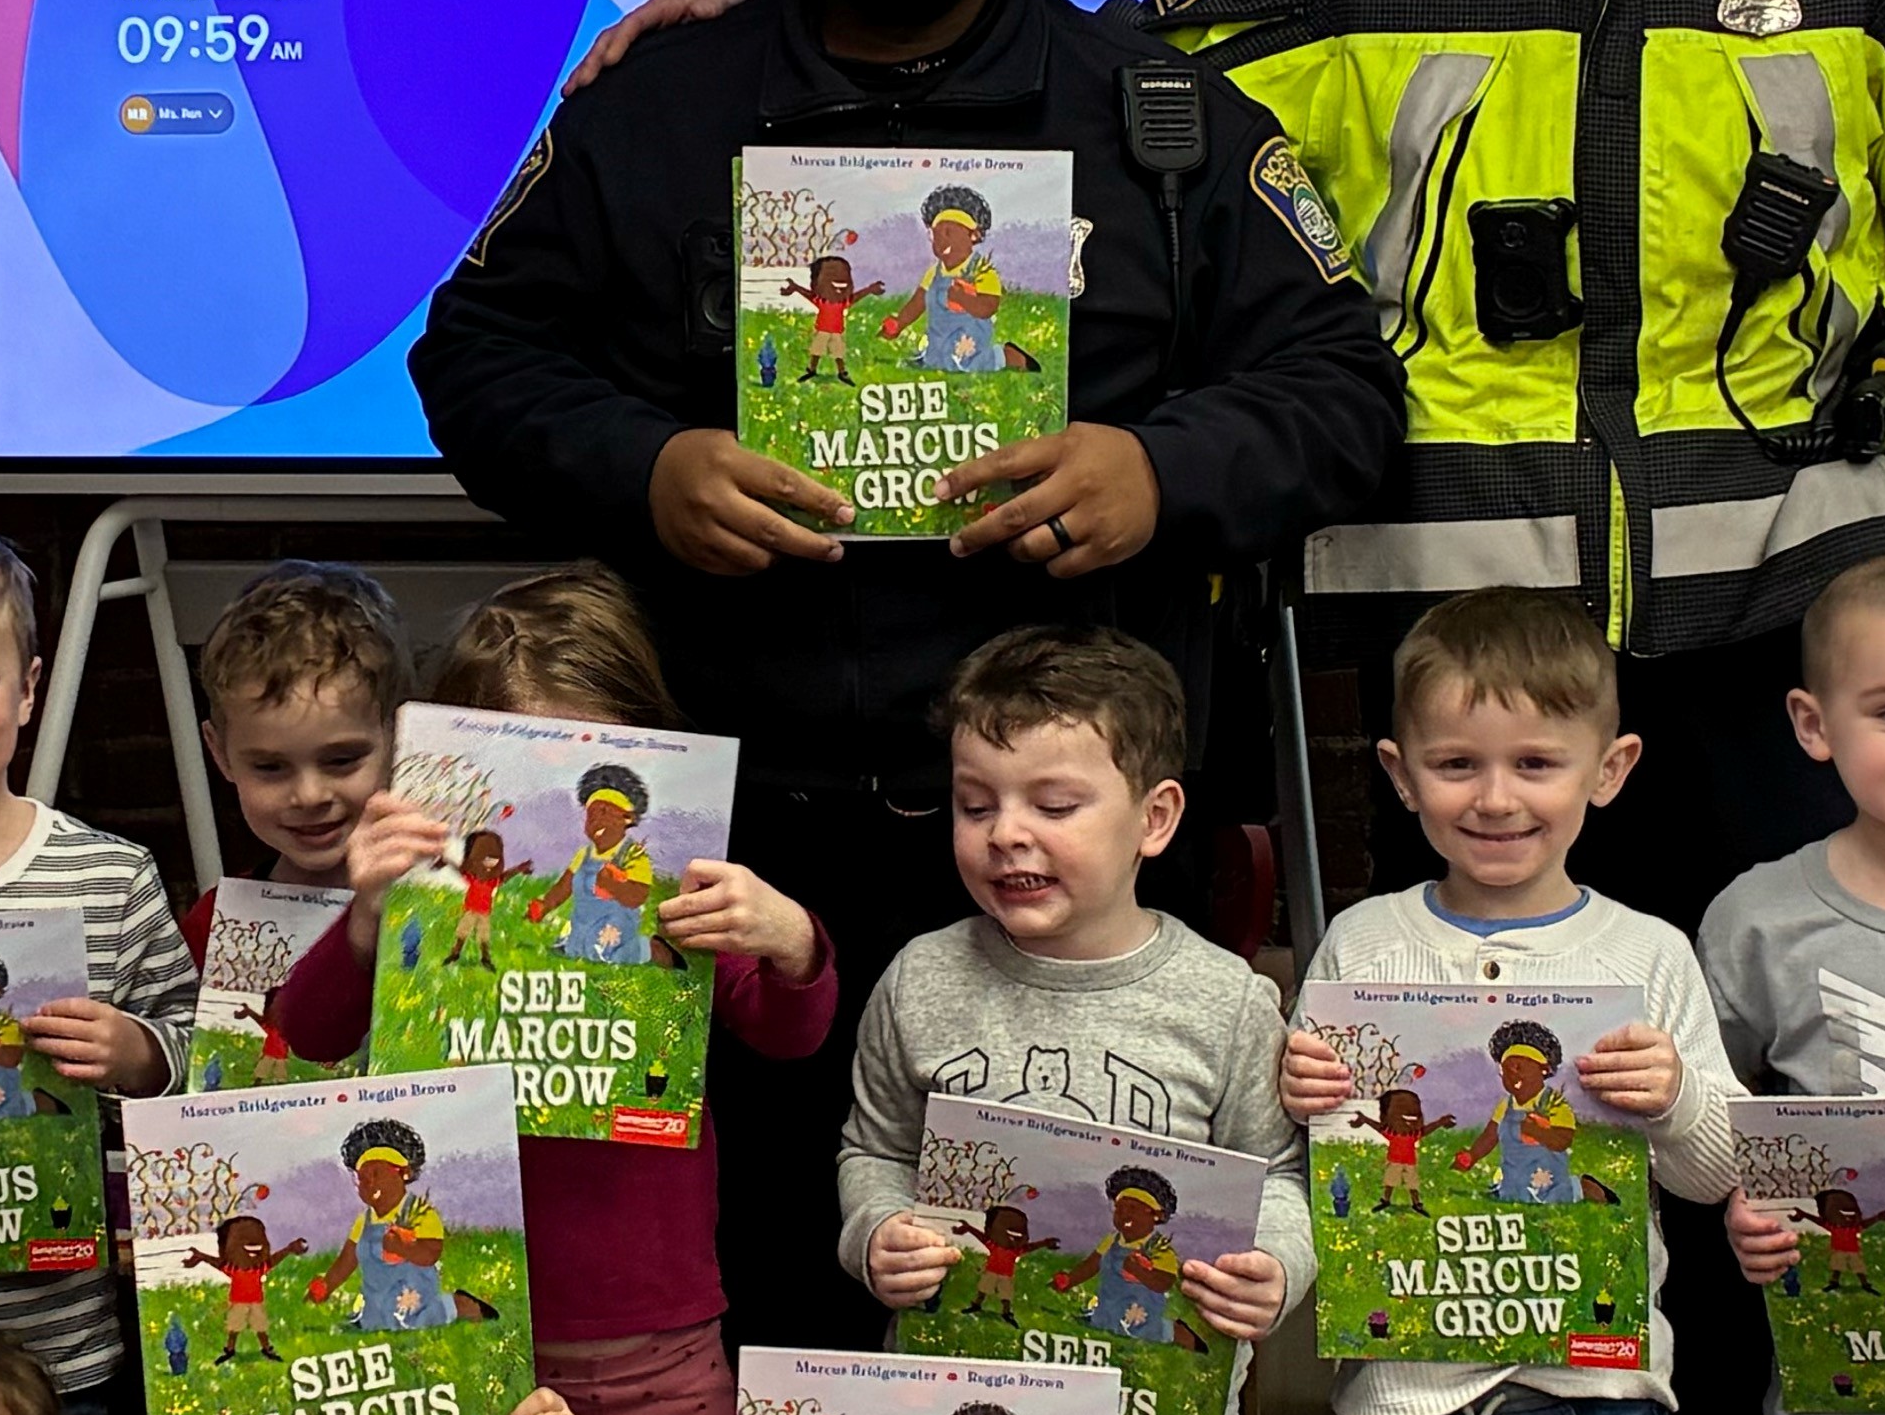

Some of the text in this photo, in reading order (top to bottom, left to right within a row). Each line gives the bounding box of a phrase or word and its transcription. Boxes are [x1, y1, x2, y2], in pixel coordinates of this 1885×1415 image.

[118, 14, 303, 63] 09:59 AM
[861, 381, 948, 422] SEE
[811, 423, 1000, 467] MARCUS
[501, 972, 586, 1013] SEE
[449, 1017, 636, 1063] MARCUS
[516, 1065, 617, 1106] ROW
[1437, 1214, 1526, 1252] SEE
[1388, 1254, 1581, 1295] MARCUS
[1436, 1298, 1565, 1338] GROW
[1023, 1330, 1112, 1366] SEE
[291, 1343, 395, 1401] SEE
